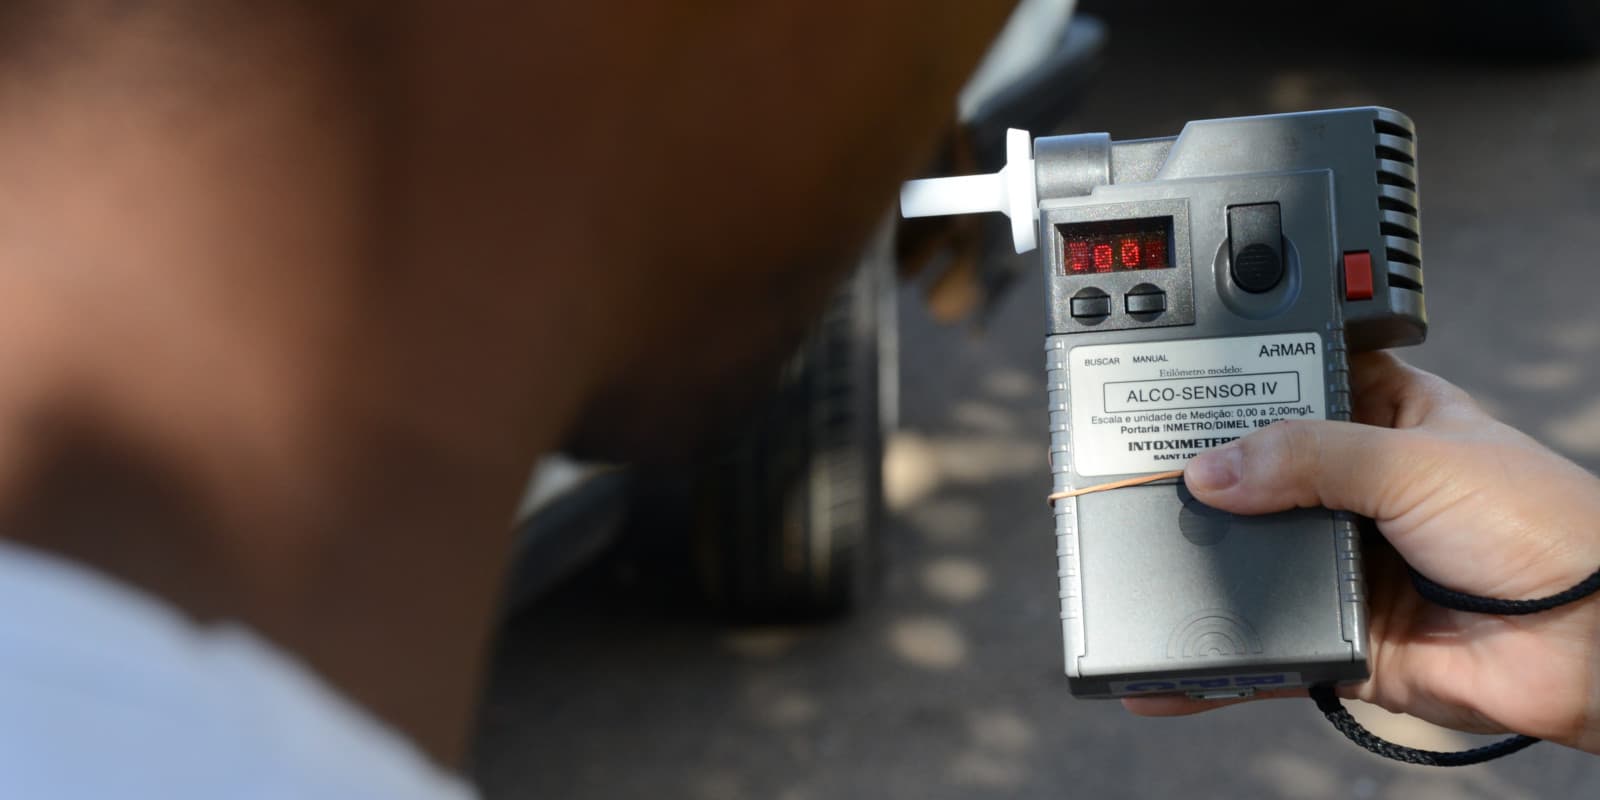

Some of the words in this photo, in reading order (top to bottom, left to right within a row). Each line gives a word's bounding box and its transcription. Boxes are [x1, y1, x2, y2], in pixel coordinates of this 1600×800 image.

[1258, 342, 1316, 358] ARMAR
[1084, 357, 1120, 367] BUSCAR
[1132, 354, 1168, 363] MANUAL
[1207, 365, 1243, 376] modelo:
[1126, 382, 1256, 403] ALCO-SENSOR
[1261, 381, 1278, 395] IV
[1091, 415, 1123, 424] Escala
[1133, 413, 1173, 422] unidade
[1175, 411, 1188, 420] de
[1190, 409, 1234, 420] Medição:
[1269, 404, 1315, 417] 2,00mg/L
[1120, 425, 1160, 434] Portaria
[1162, 420, 1250, 432] INMETRO/DIMEL
[1128, 436, 1240, 451] INTOXIMETE
